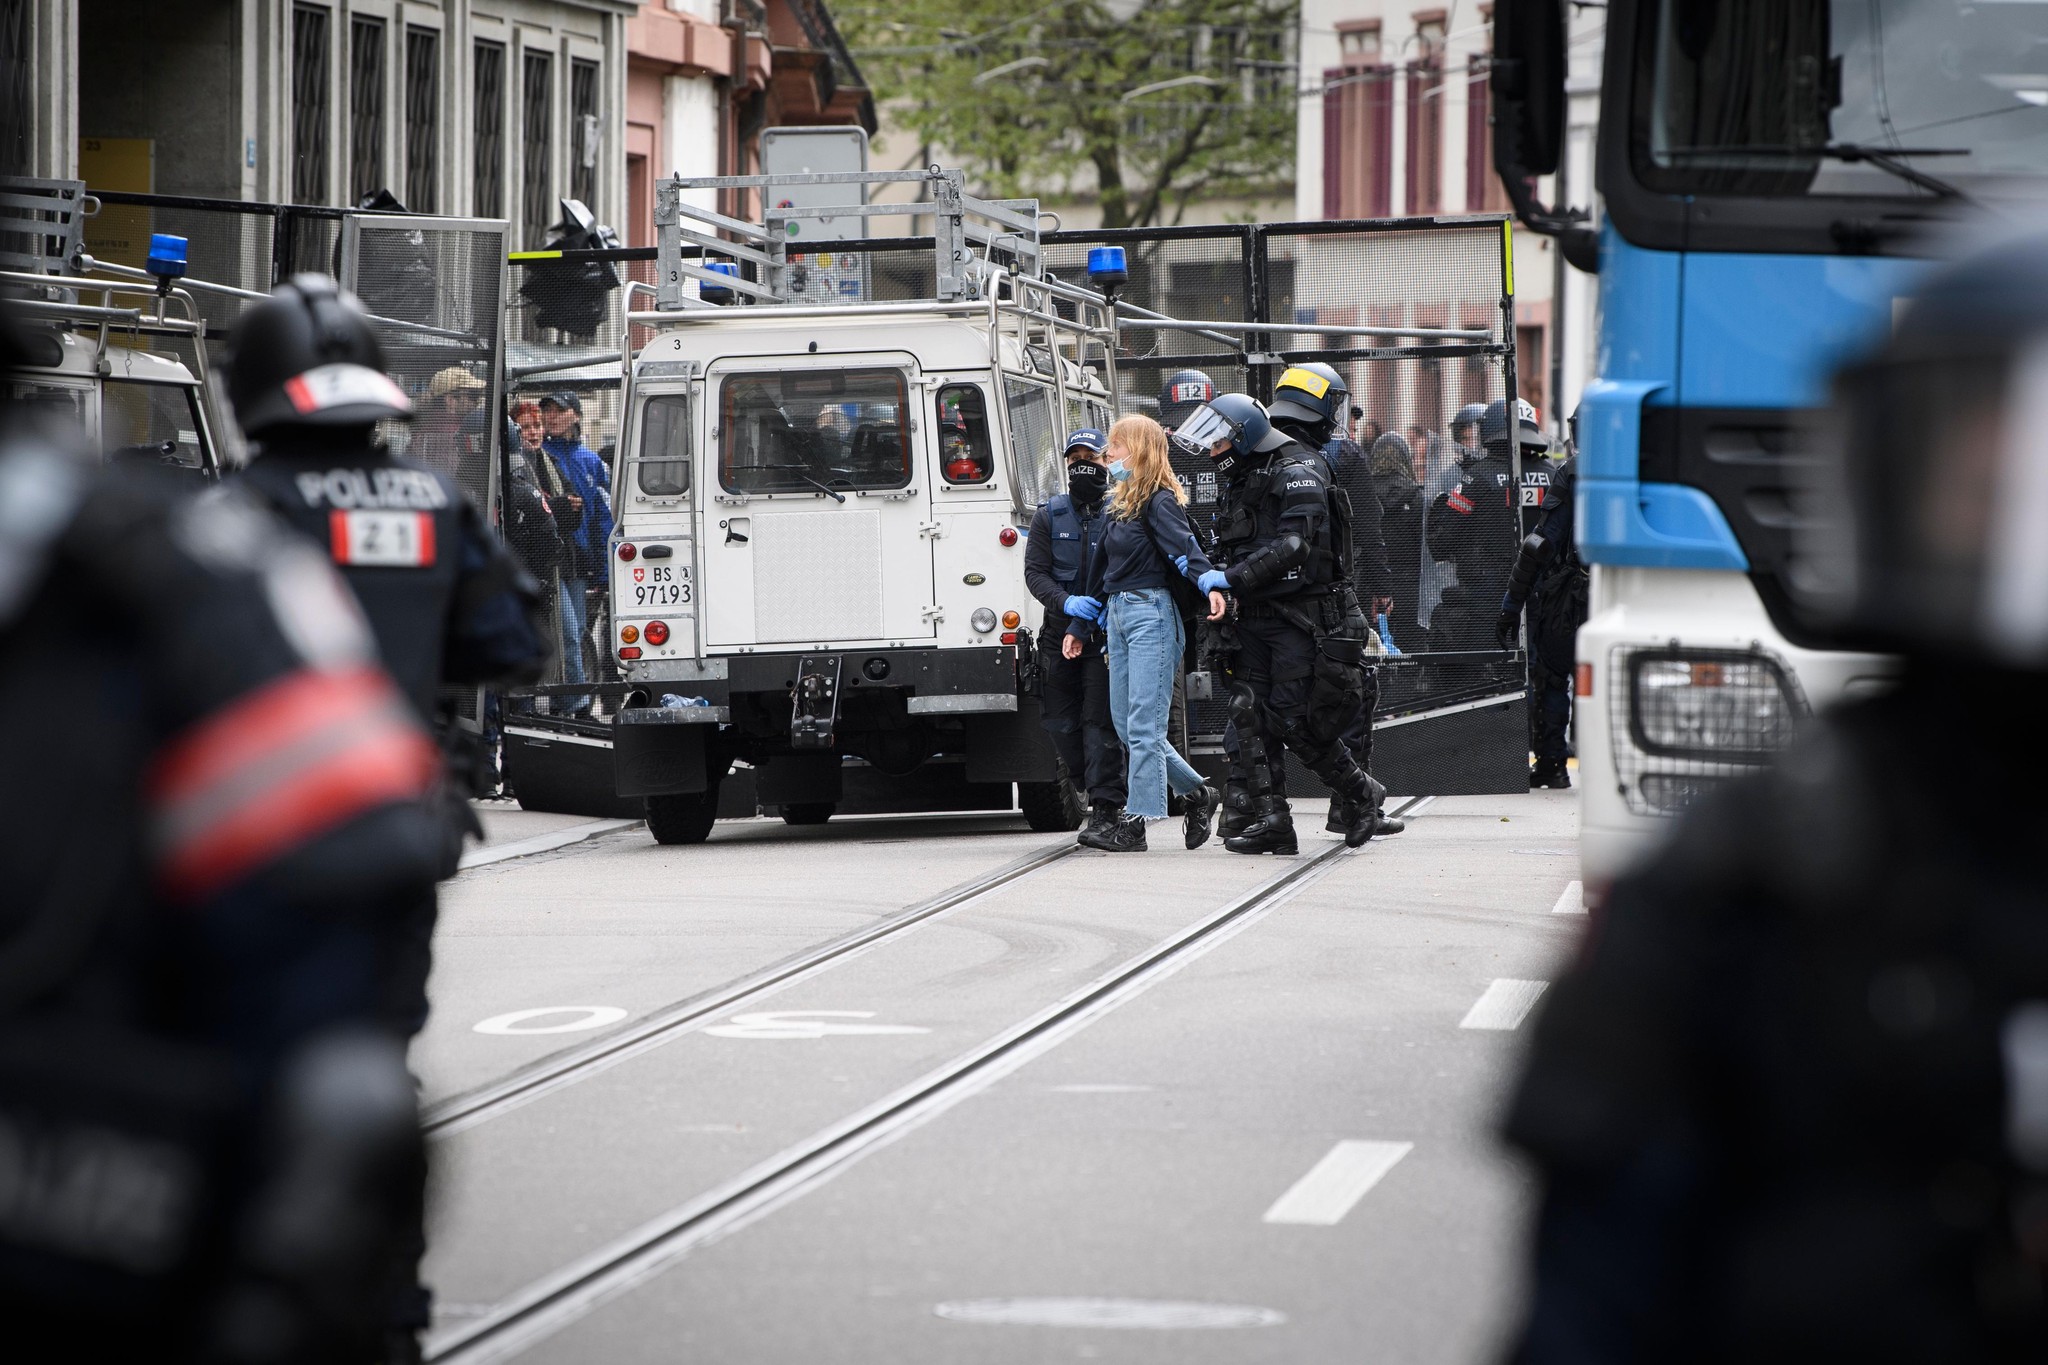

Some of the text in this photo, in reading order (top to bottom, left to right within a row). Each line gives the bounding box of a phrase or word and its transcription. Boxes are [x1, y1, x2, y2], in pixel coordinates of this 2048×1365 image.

[953, 216, 961, 227] 3
[953, 250, 961, 261] 2
[670, 270, 678, 282] 3
[673, 339, 681, 350] 3
[1184, 384, 1201, 398] 12
[1519, 406, 1533, 419] 12
[1070, 432, 1097, 443] POLIZEI
[1070, 465, 1096, 476] OLIZEI
[1217, 456, 1235, 472] IZEI
[1177, 472, 1216, 486] OLIZEI
[1286, 479, 1317, 490] POLIZEI
[1497, 472, 1551, 487] PIZEI
[296, 467, 449, 508] POLIZEI
[1525, 490, 1534, 503] 2
[362, 521, 411, 553] 21
[653, 567, 672, 582] BS
[635, 584, 691, 605] 97193
